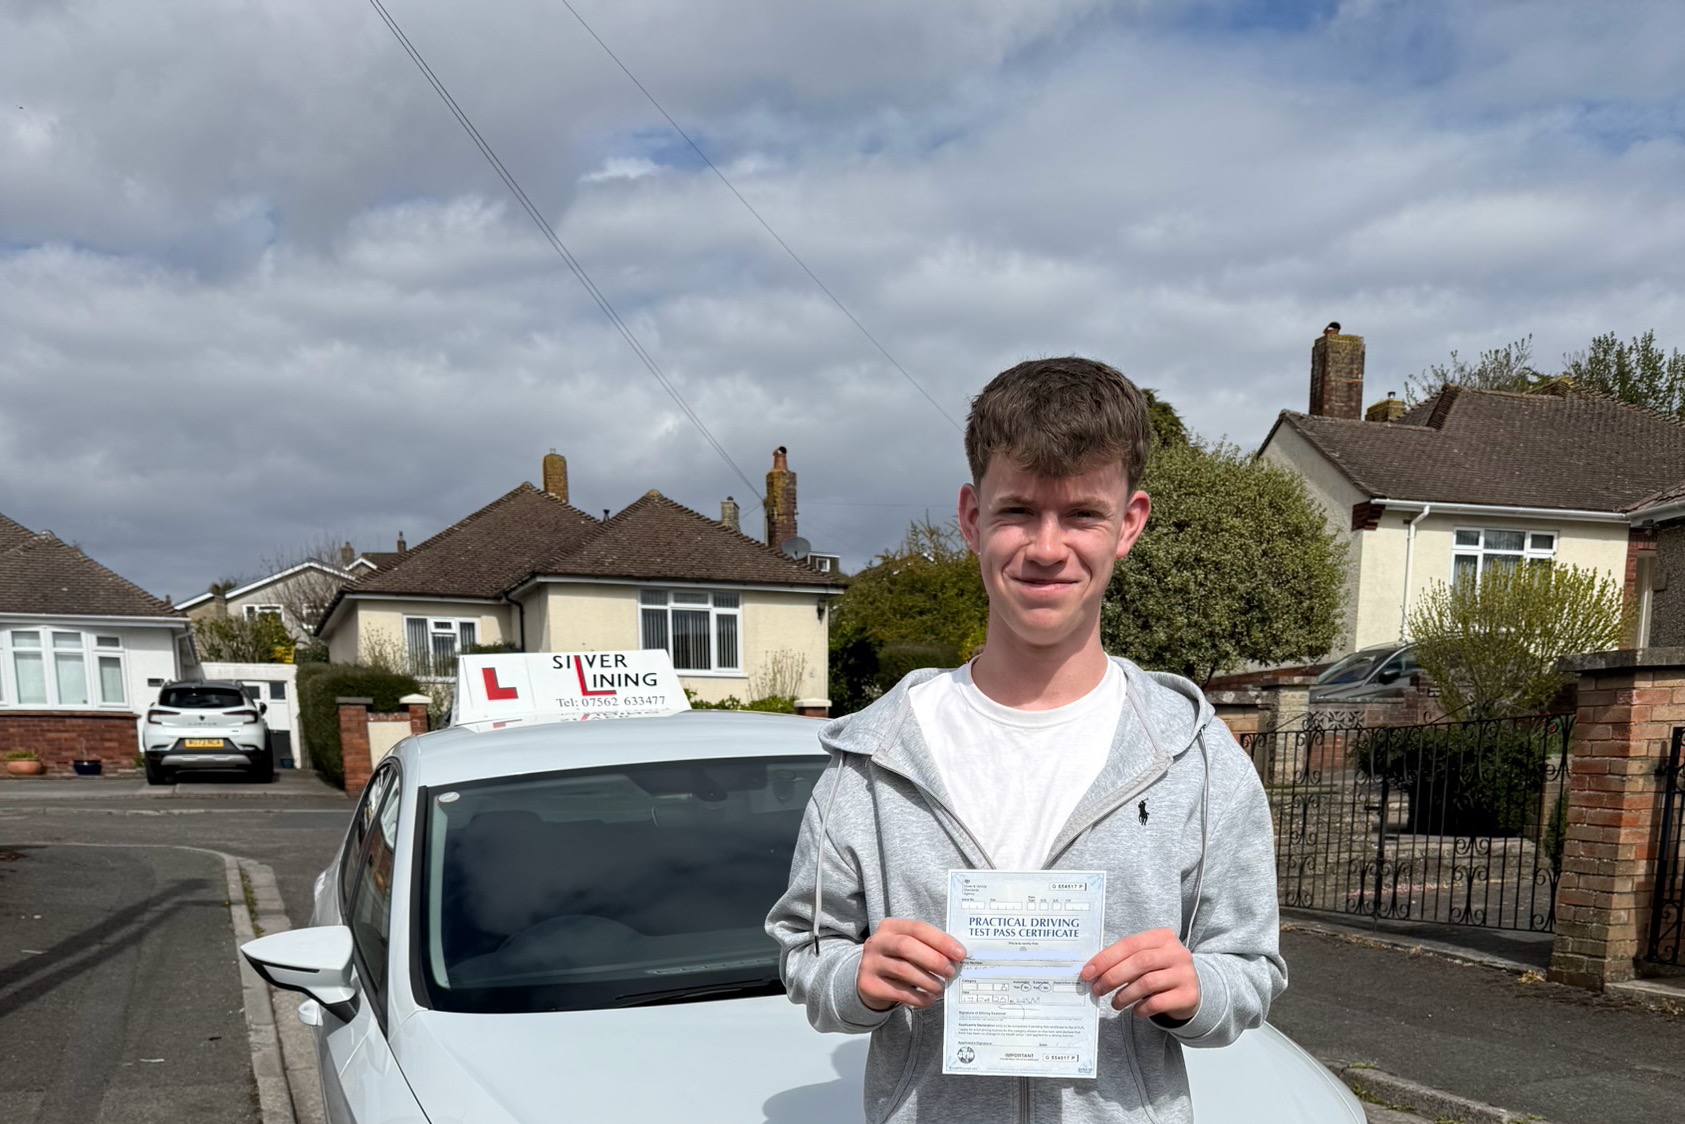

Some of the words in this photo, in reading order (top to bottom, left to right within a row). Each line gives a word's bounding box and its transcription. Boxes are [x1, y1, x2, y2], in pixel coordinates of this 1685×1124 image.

[482, 667, 519, 701] L
[556, 698, 578, 708] Tel:
[581, 697, 619, 708] 07562
[624, 696, 666, 706] 633477
[969, 917, 1028, 928] PRACTICAL
[1030, 918, 1080, 928] DRIVING
[969, 928, 991, 937] TEST
[993, 928, 1016, 937] PASS
[1019, 928, 1080, 938] CERTIFICATE
